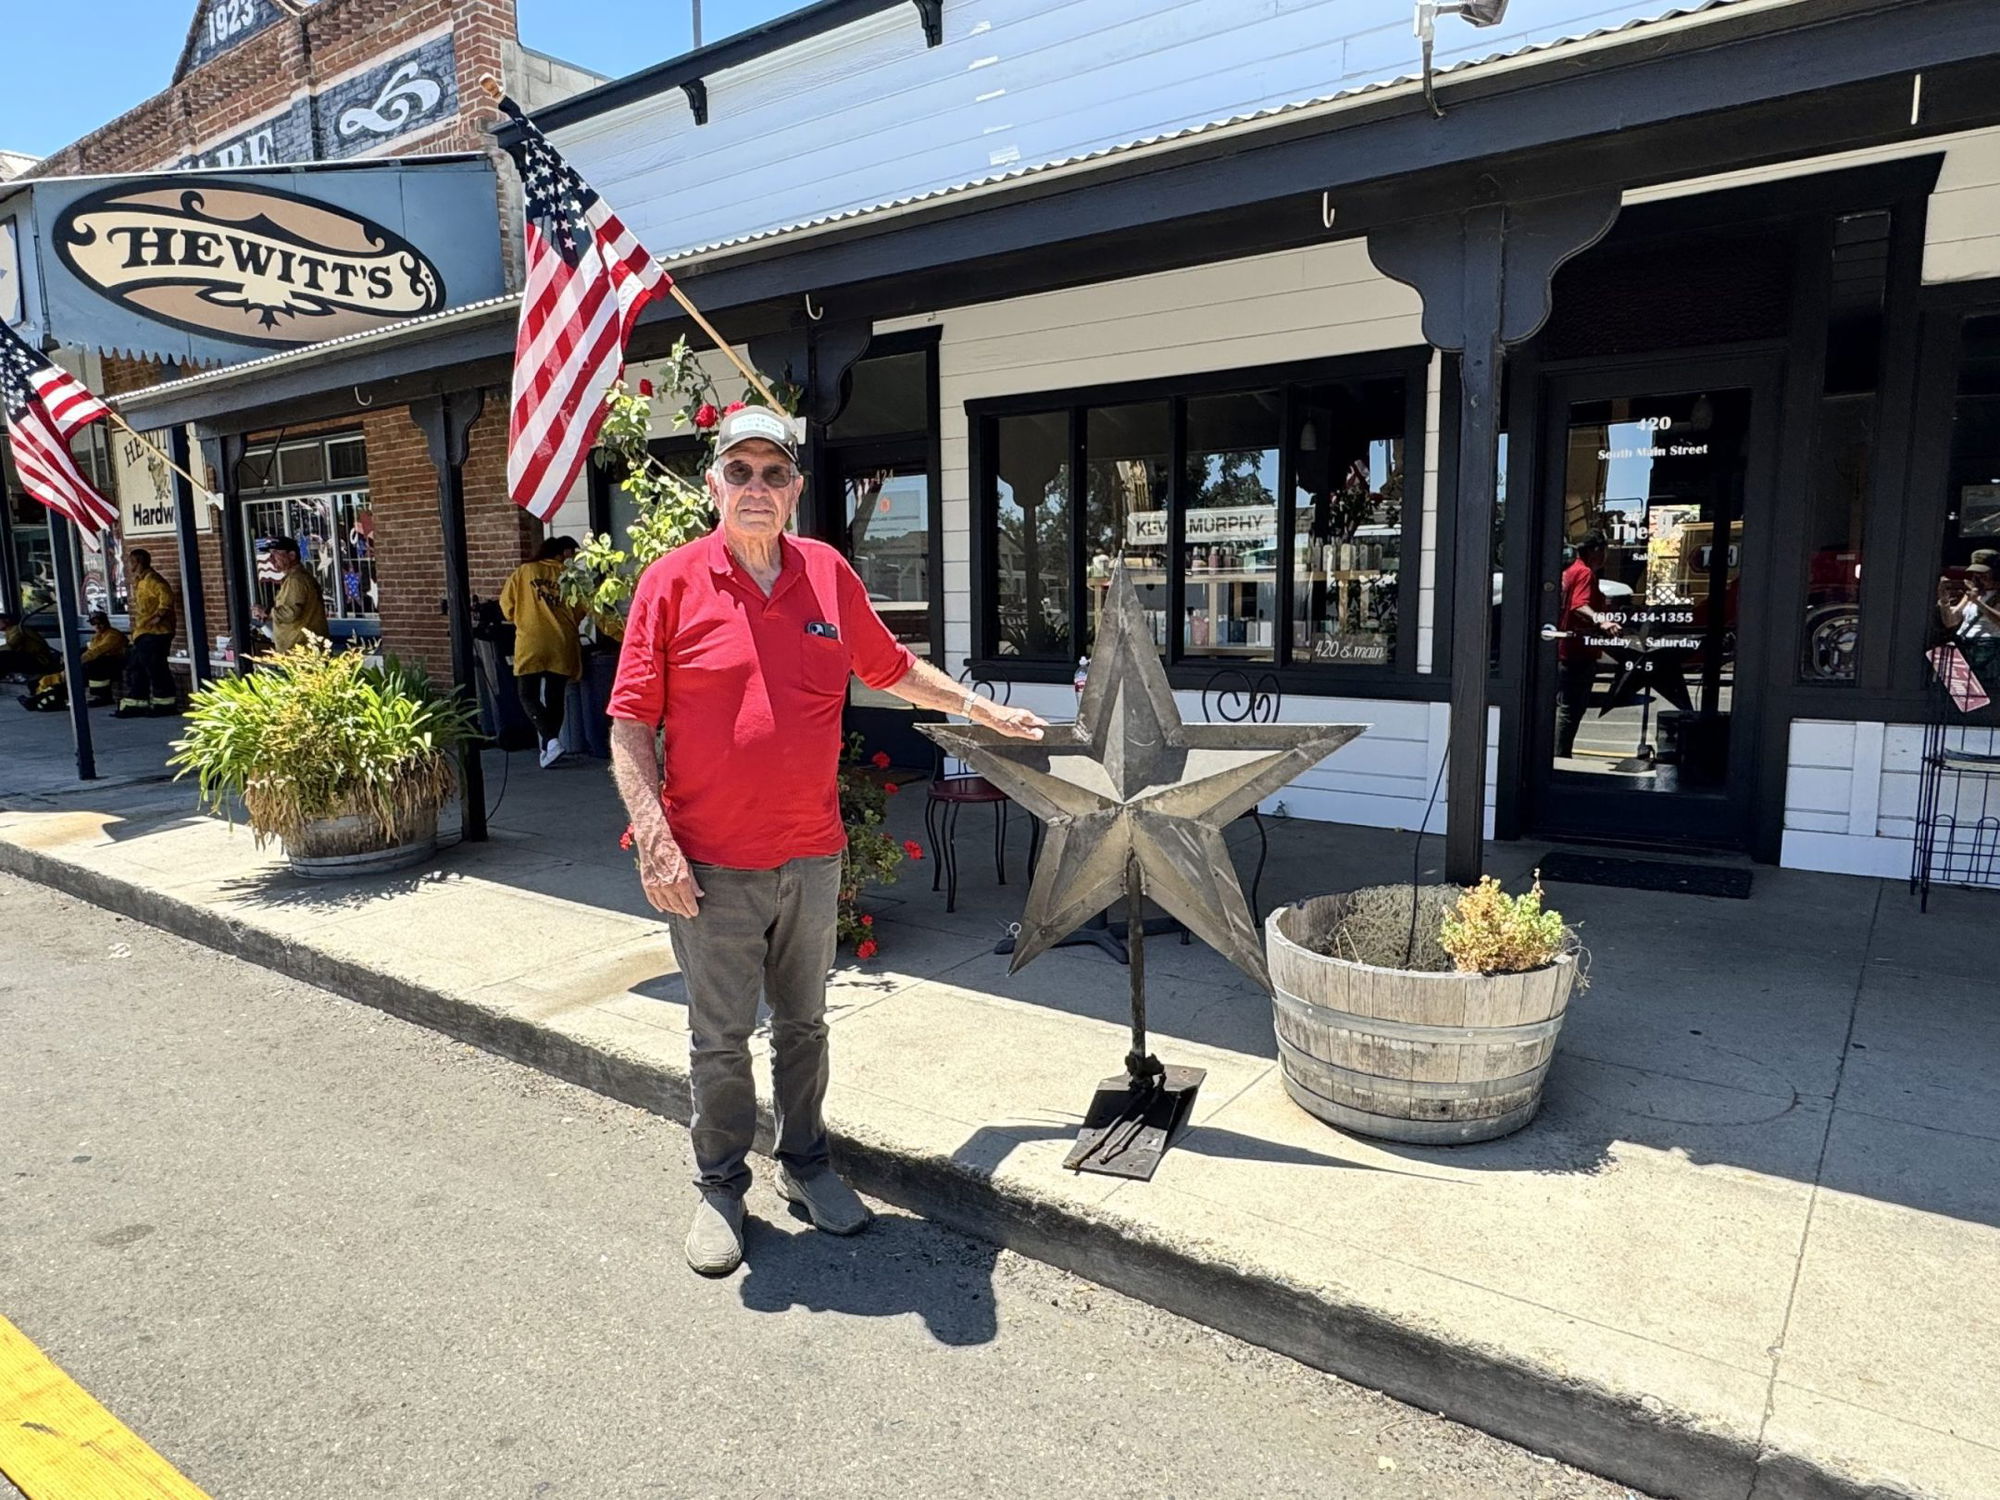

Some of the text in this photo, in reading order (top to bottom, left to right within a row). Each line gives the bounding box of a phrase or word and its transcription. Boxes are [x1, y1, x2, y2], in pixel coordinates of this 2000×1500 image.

[208, 0, 254, 47] 1923
[106, 226, 393, 300] HEWITT'S
[1636, 416, 1672, 431] 420
[1598, 444, 1708, 460] South Main Street
[133, 502, 174, 526] Hardw
[1631, 612, 1694, 623] 434-1355
[1315, 640, 1339, 657] 420
[1584, 636, 1631, 648] Tuesday
[1645, 637, 1701, 650] Saturday
